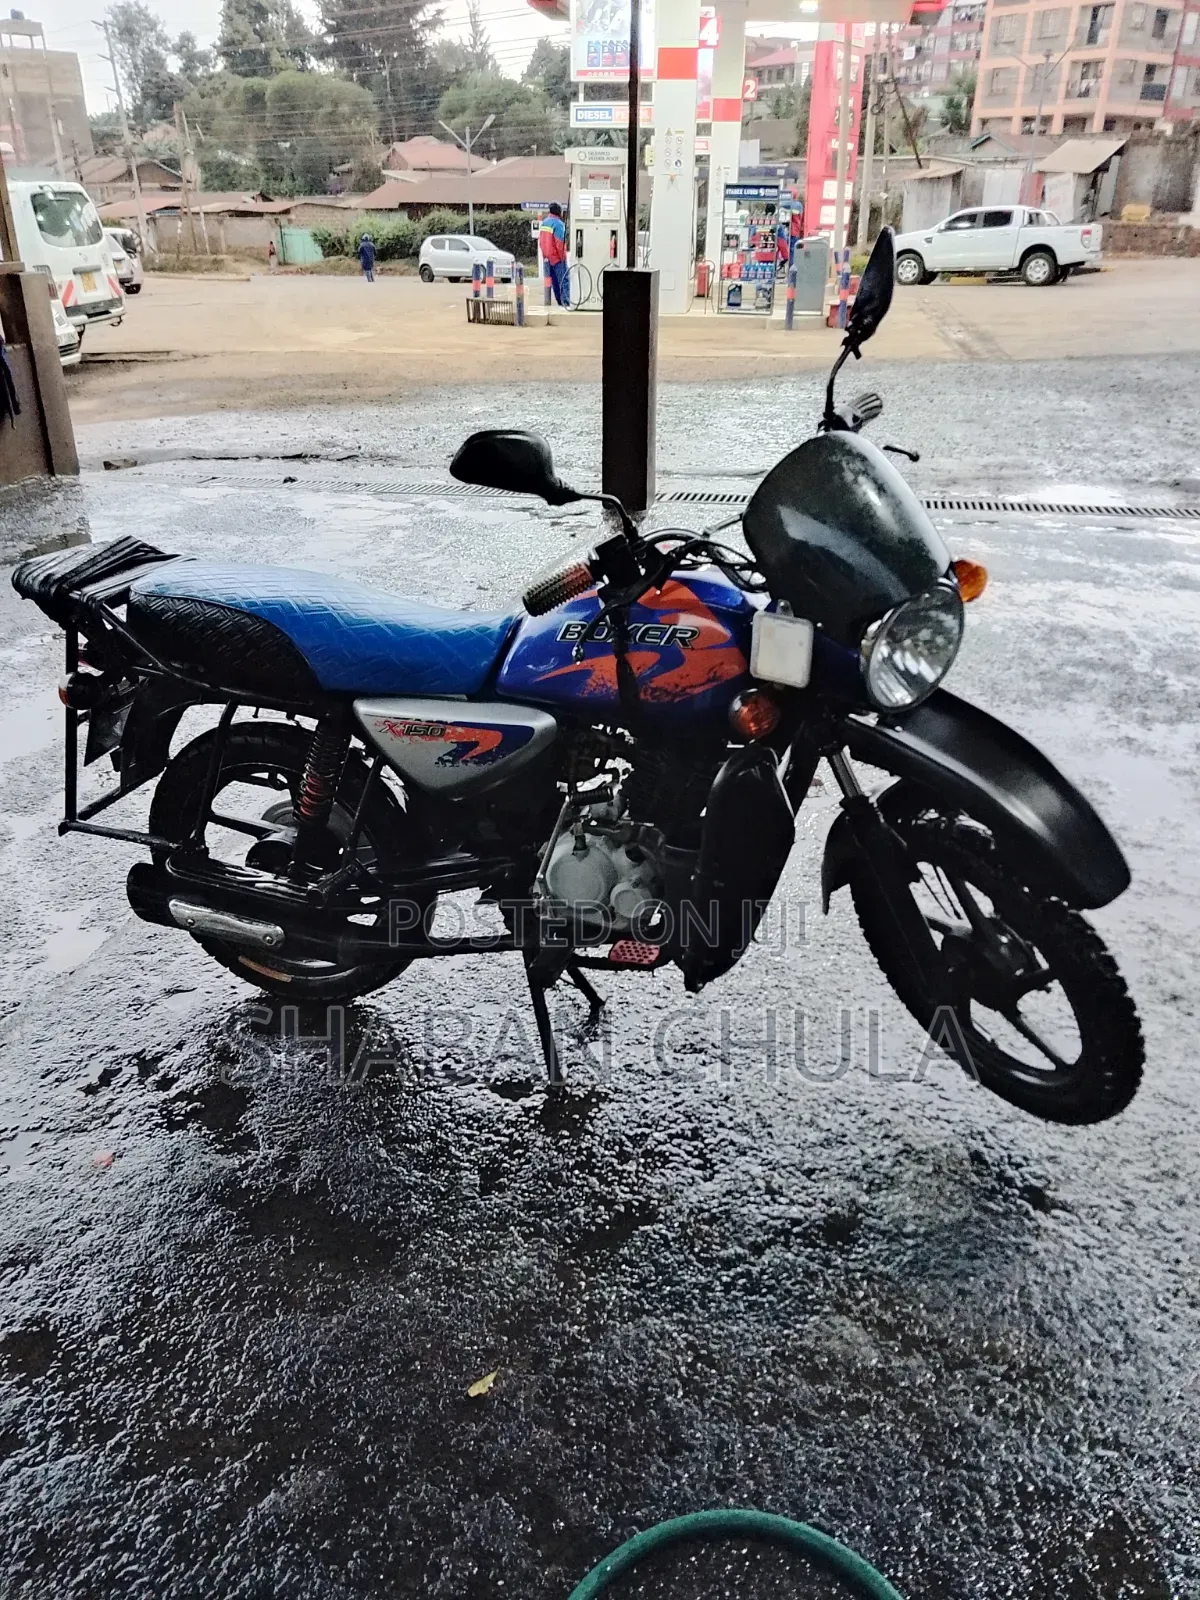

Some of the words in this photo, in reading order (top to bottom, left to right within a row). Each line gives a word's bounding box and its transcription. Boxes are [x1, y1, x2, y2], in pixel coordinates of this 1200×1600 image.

[700, 17, 719, 46] 4
[744, 79, 756, 98] 2
[577, 110, 612, 120] DIESEL
[615, 110, 650, 120] PEOL
